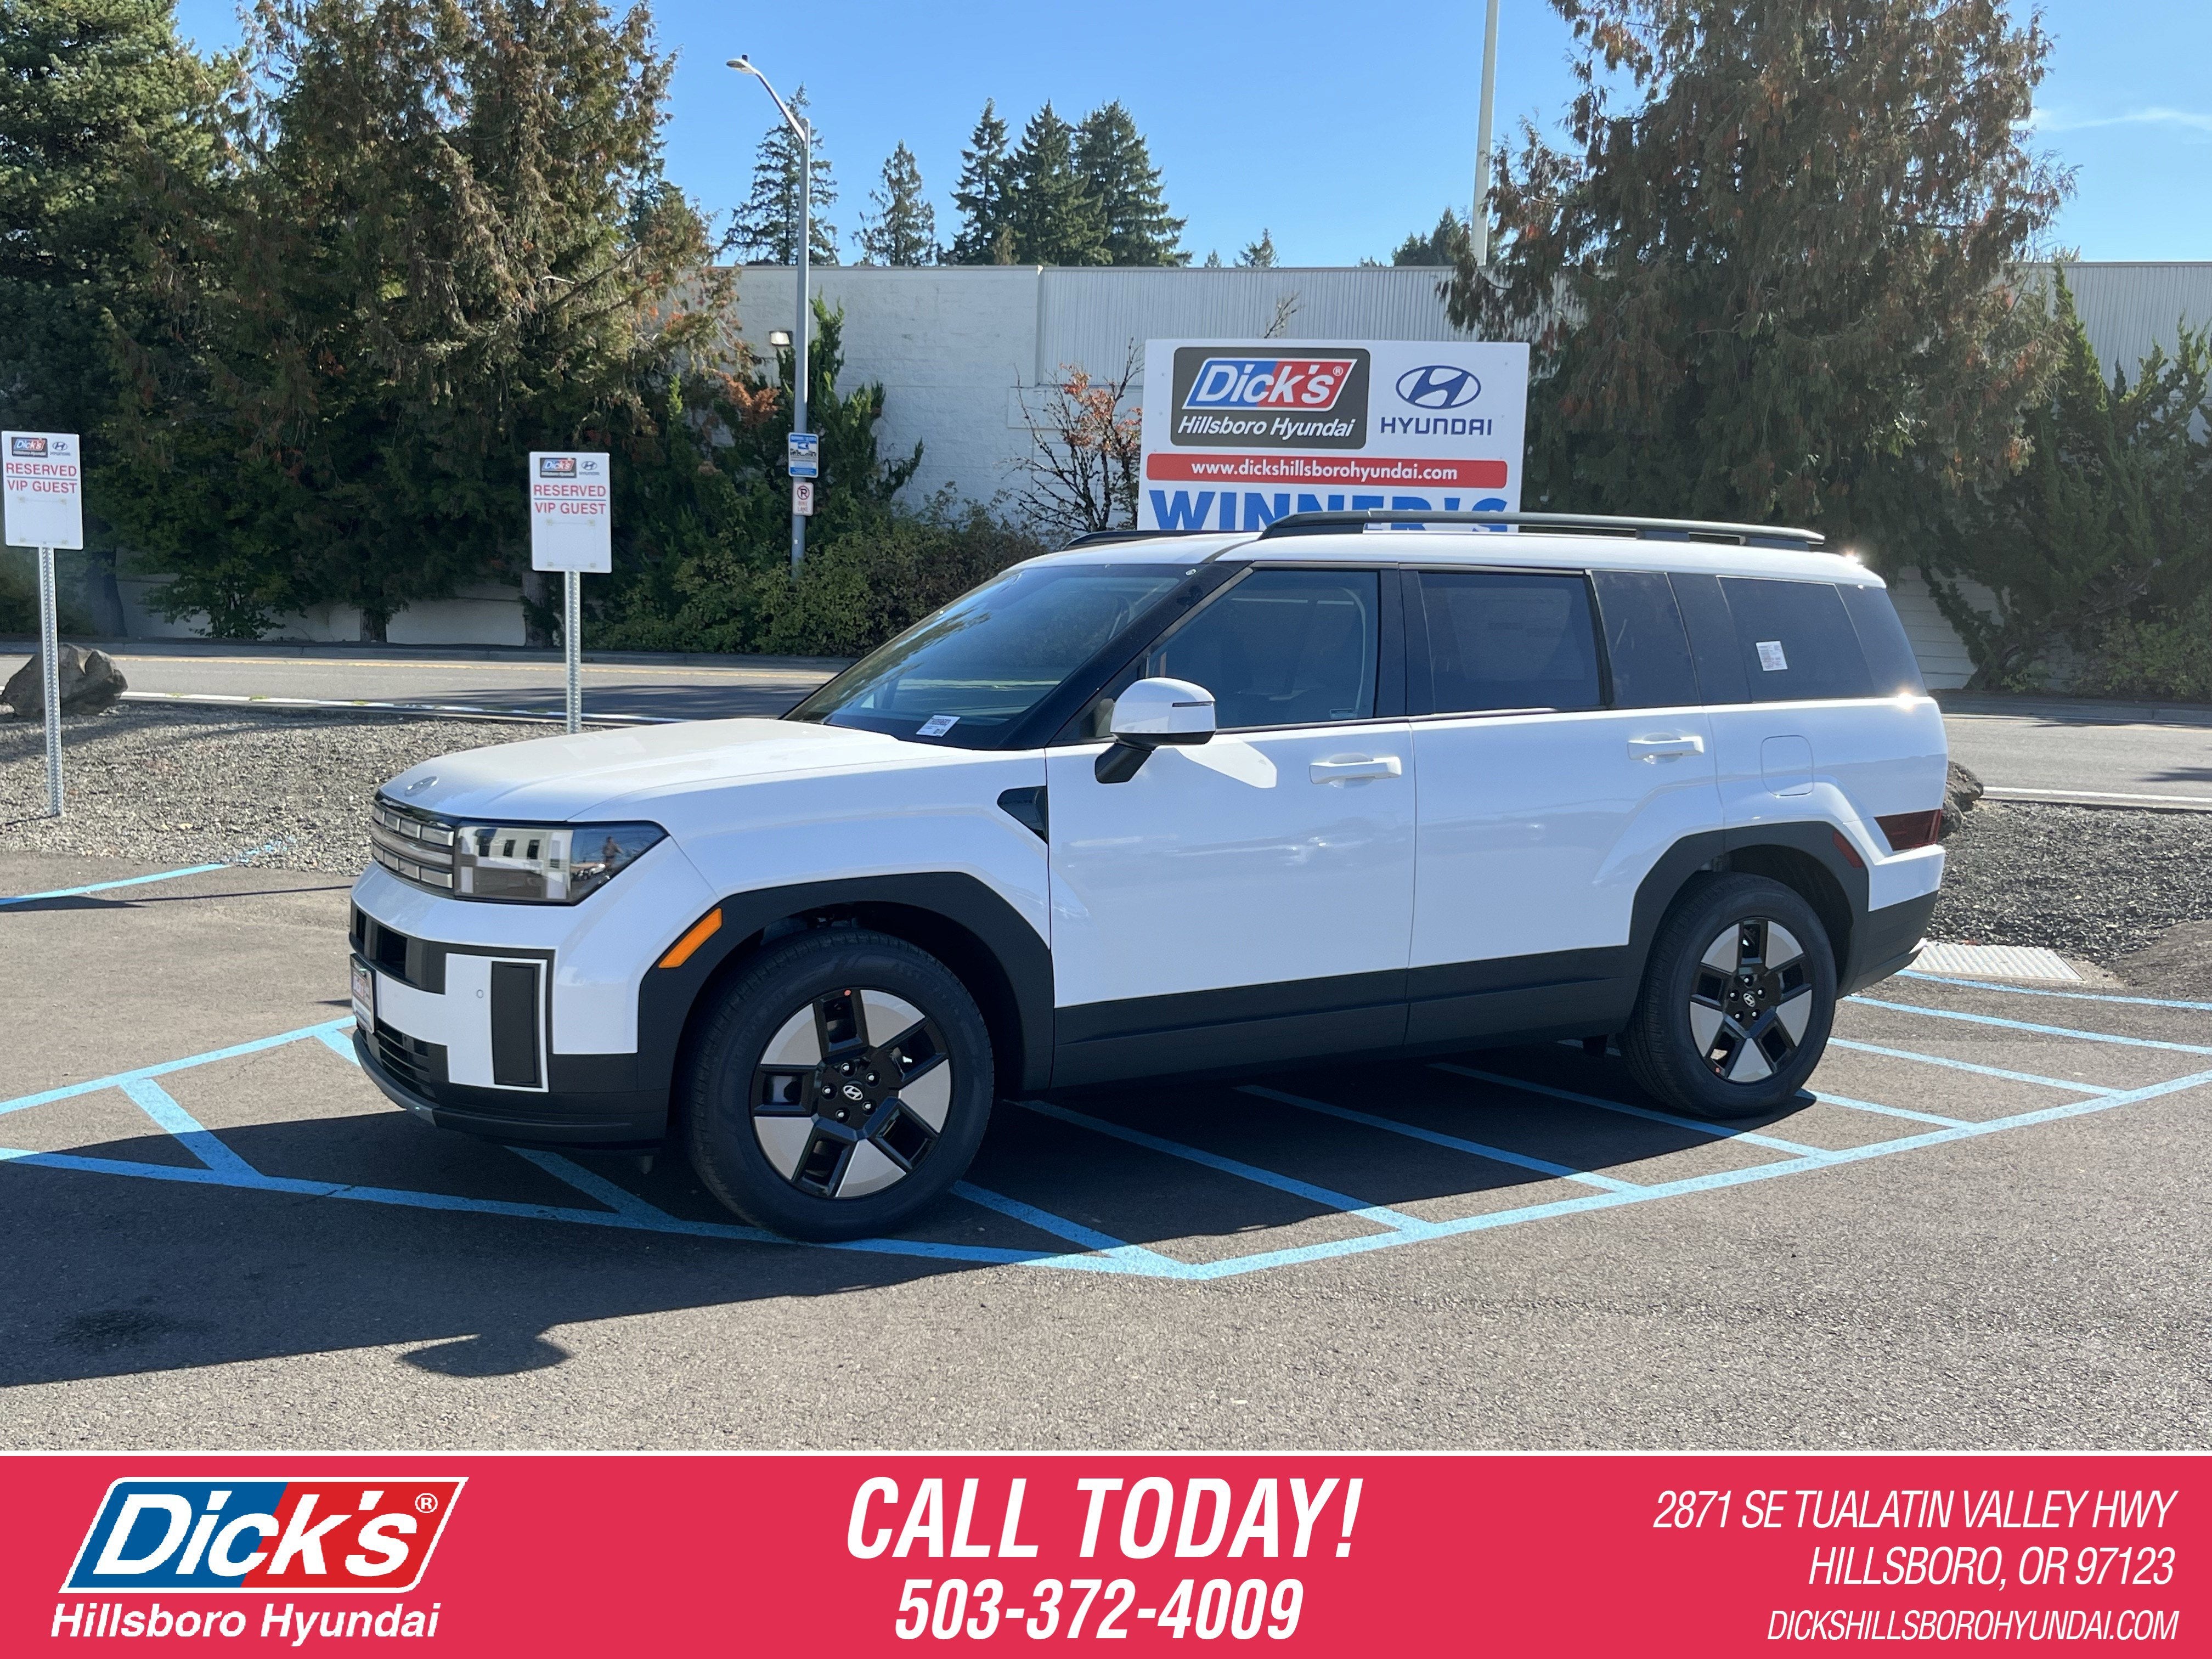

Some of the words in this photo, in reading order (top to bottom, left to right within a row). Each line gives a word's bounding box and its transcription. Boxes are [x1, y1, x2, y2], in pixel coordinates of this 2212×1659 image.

[1196, 364, 1334, 404] Dick's
[1178, 416, 1267, 435] Hillsboro
[1270, 417, 1356, 440] Hyundai
[1380, 417, 1492, 436] HYUNDAI
[16, 439, 43, 449] Dick's
[6, 462, 77, 476] RESERVED
[1191, 459, 1458, 483] www.dickshillsborohyundai.com
[8, 479, 28, 491] VIP
[32, 481, 77, 493] GUEST
[534, 484, 606, 497] RESERVED
[535, 502, 556, 514] VIP
[561, 503, 606, 515] GUEST
